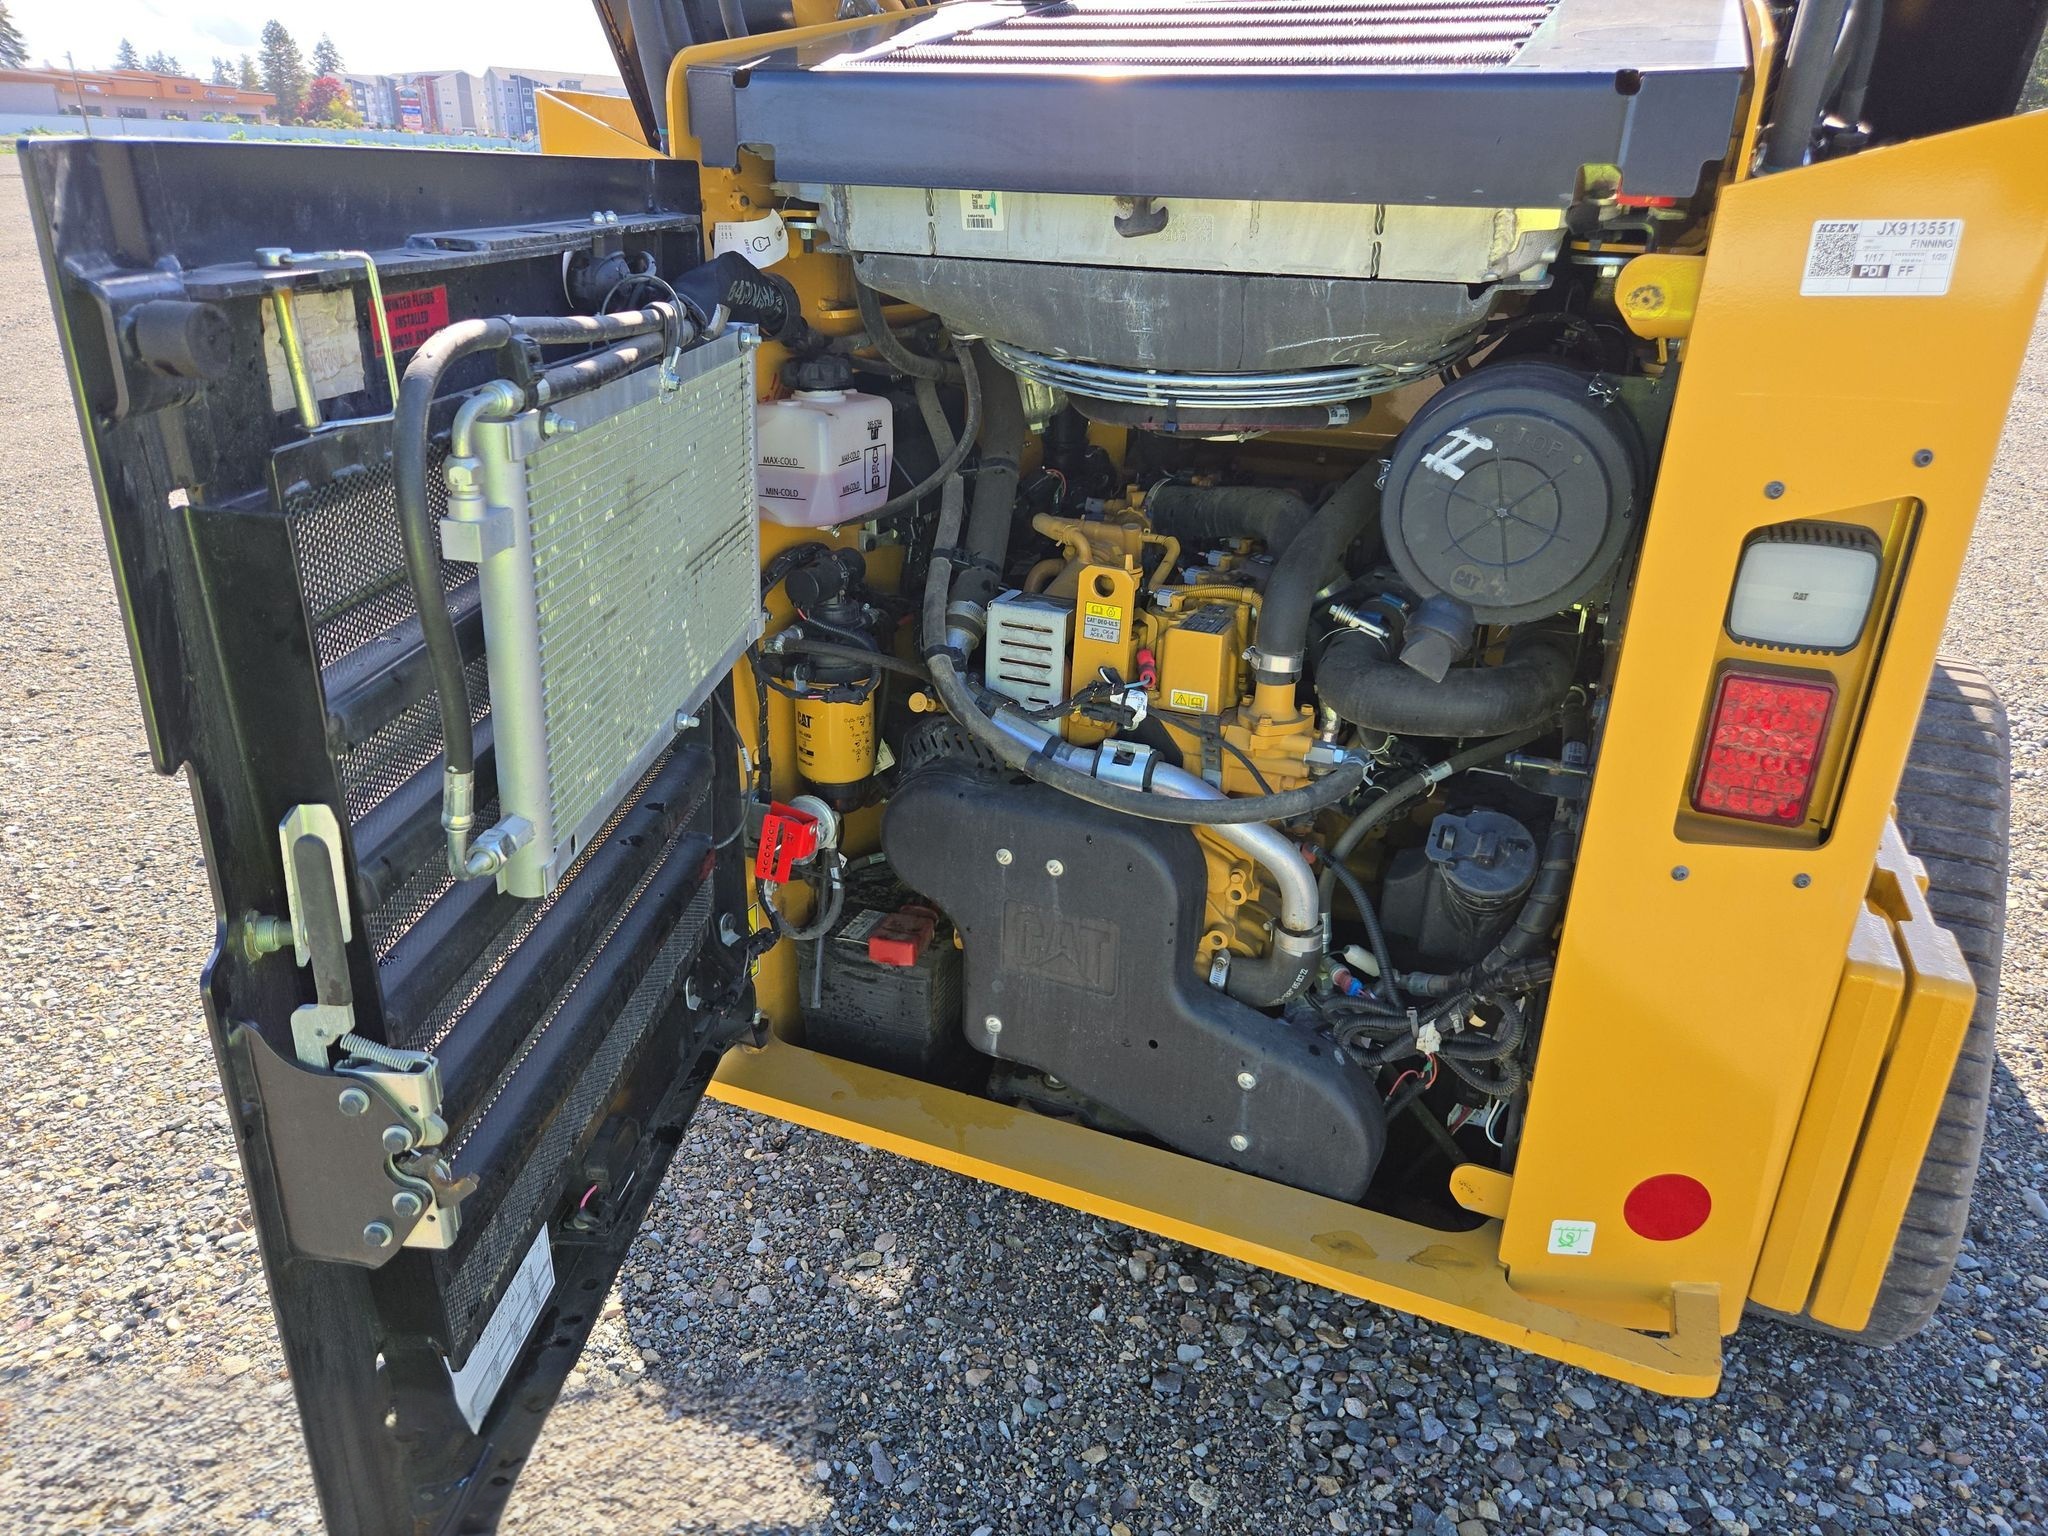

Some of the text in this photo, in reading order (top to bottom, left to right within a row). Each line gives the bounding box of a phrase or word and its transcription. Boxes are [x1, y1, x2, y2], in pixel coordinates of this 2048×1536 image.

[1817, 222, 1956, 236] KEEN JX913551
[1910, 239, 1953, 249] FINNING
[1859, 265, 1915, 277] PDI FF
[763, 456, 798, 466] MAX-COLD
[765, 488, 799, 497] MIN-COLD
[798, 711, 814, 729] CAT
